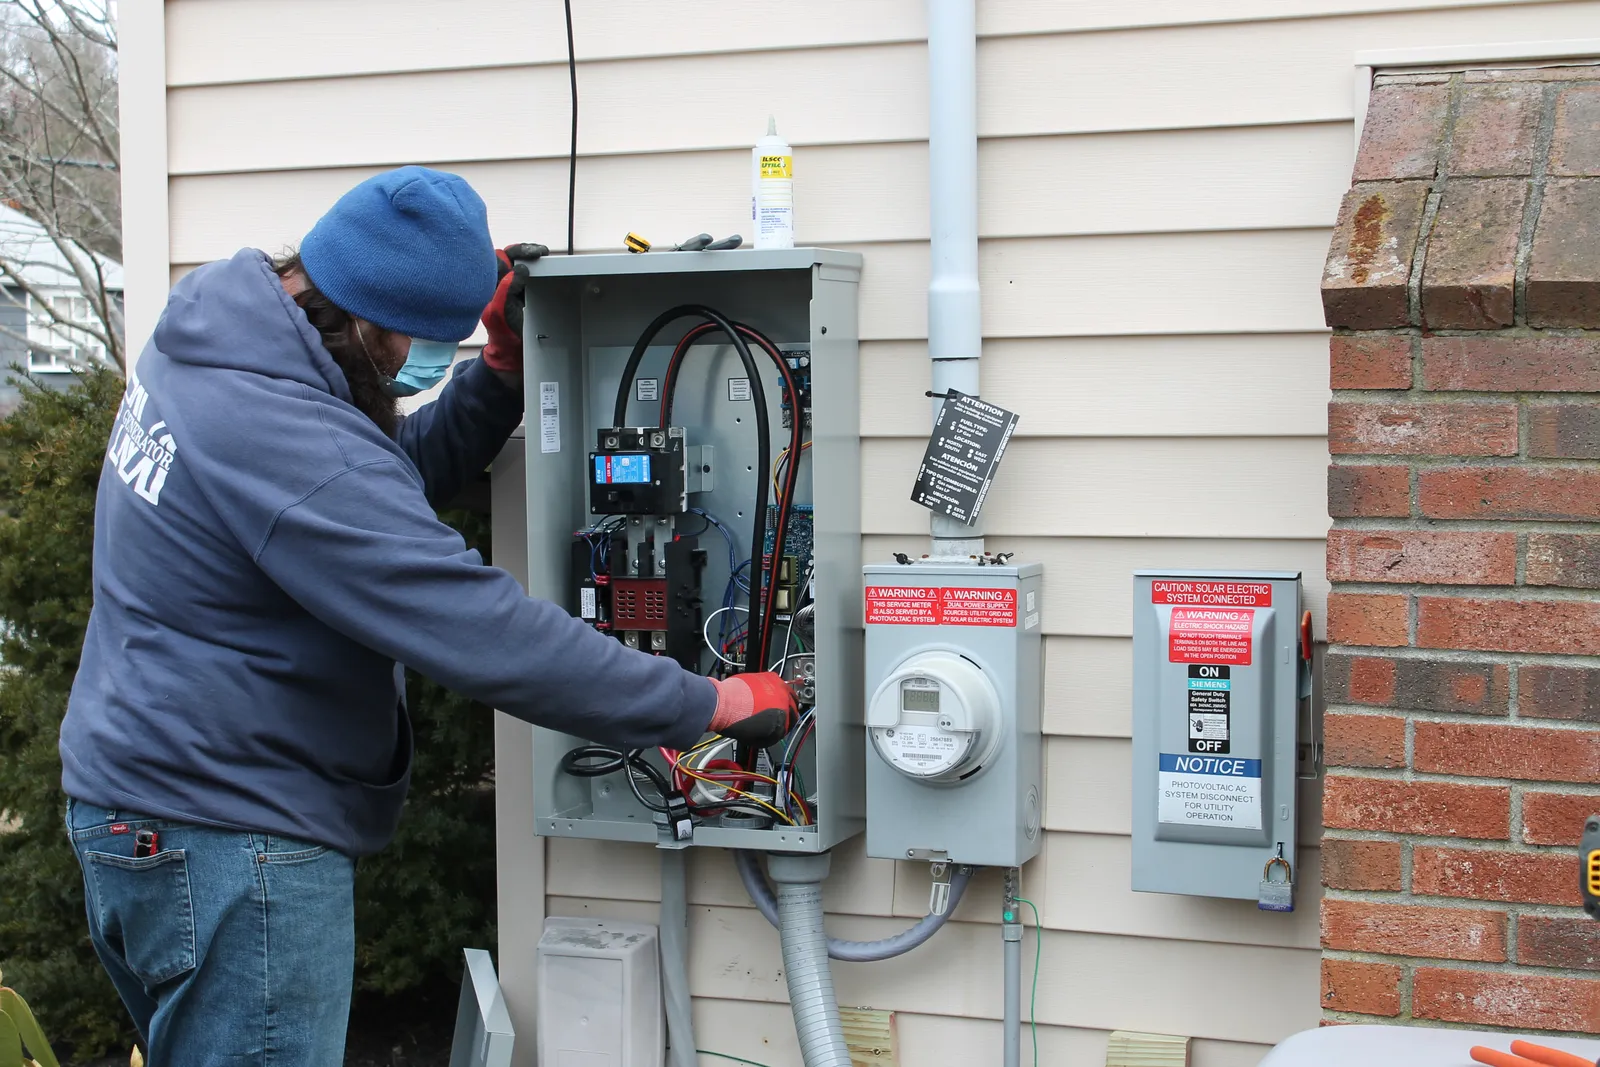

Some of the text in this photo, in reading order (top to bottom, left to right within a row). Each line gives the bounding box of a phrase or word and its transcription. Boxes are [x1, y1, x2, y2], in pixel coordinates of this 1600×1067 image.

[961, 395, 1004, 418] ATTENTION
[960, 418, 973, 427] FUEL
[958, 423, 975, 433] Natural
[122, 409, 174, 471] GENERATOR
[946, 439, 963, 448] NORTH
[954, 434, 981, 450] LOCATION:
[944, 443, 960, 453] SOUTH
[975, 450, 987, 458] EAST
[941, 451, 978, 472] ATENCIÓN
[973, 455, 987, 464] WEST
[945, 483, 961, 493] natural
[926, 495, 941, 504] NORTE
[951, 511, 966, 520] OESTE
[878, 588, 926, 598] WARNING
[1154, 582, 1269, 595] CAUTION: SOLAR ELECTRIC
[953, 590, 1002, 601] WARNING
[1166, 593, 1256, 605] SYSTEM CONNECTED
[1186, 611, 1239, 620] WARNING
[1224, 623, 1249, 631] HAZARD
[1199, 667, 1219, 677] ON
[1191, 680, 1227, 688] SIEMENS
[1196, 740, 1222, 751] OFF
[1175, 757, 1246, 775] NOTICE
[1171, 780, 1247, 793] PHOTOVOLTAIC AC
[1165, 791, 1254, 803] SYSTEM DISCONNECT
[1184, 802, 1234, 811] FOR UTILITY
[1185, 811, 1233, 821] OPERATION
